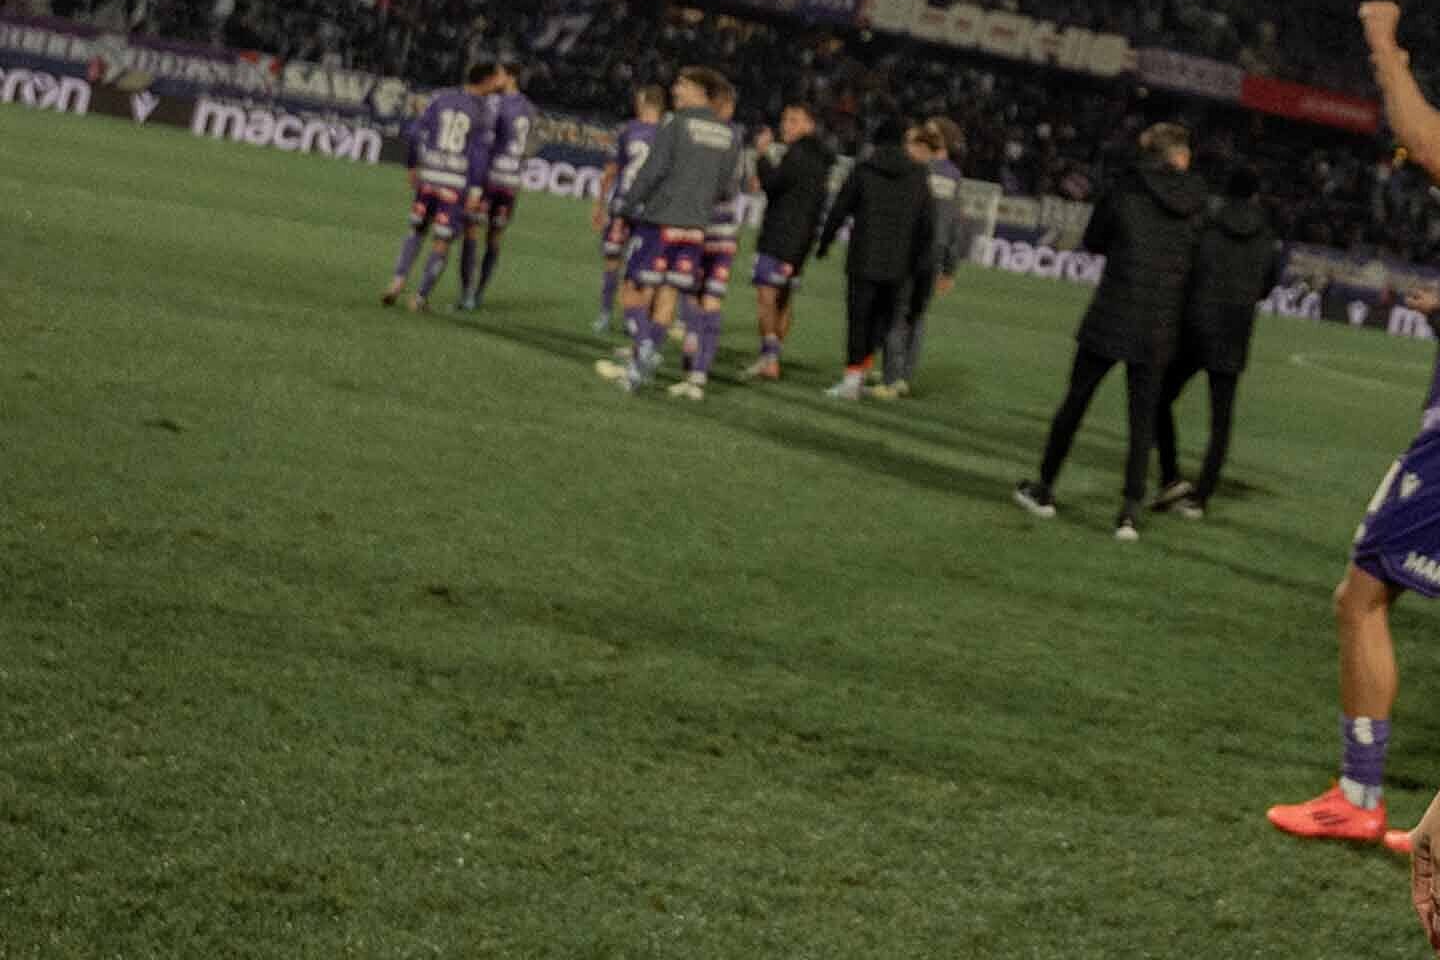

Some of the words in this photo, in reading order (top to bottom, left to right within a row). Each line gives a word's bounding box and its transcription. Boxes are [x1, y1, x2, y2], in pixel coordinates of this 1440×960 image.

[0, 67, 92, 116] ron
[191, 95, 383, 165] macron
[437, 108, 471, 153] 18
[970, 235, 1107, 283] macro
